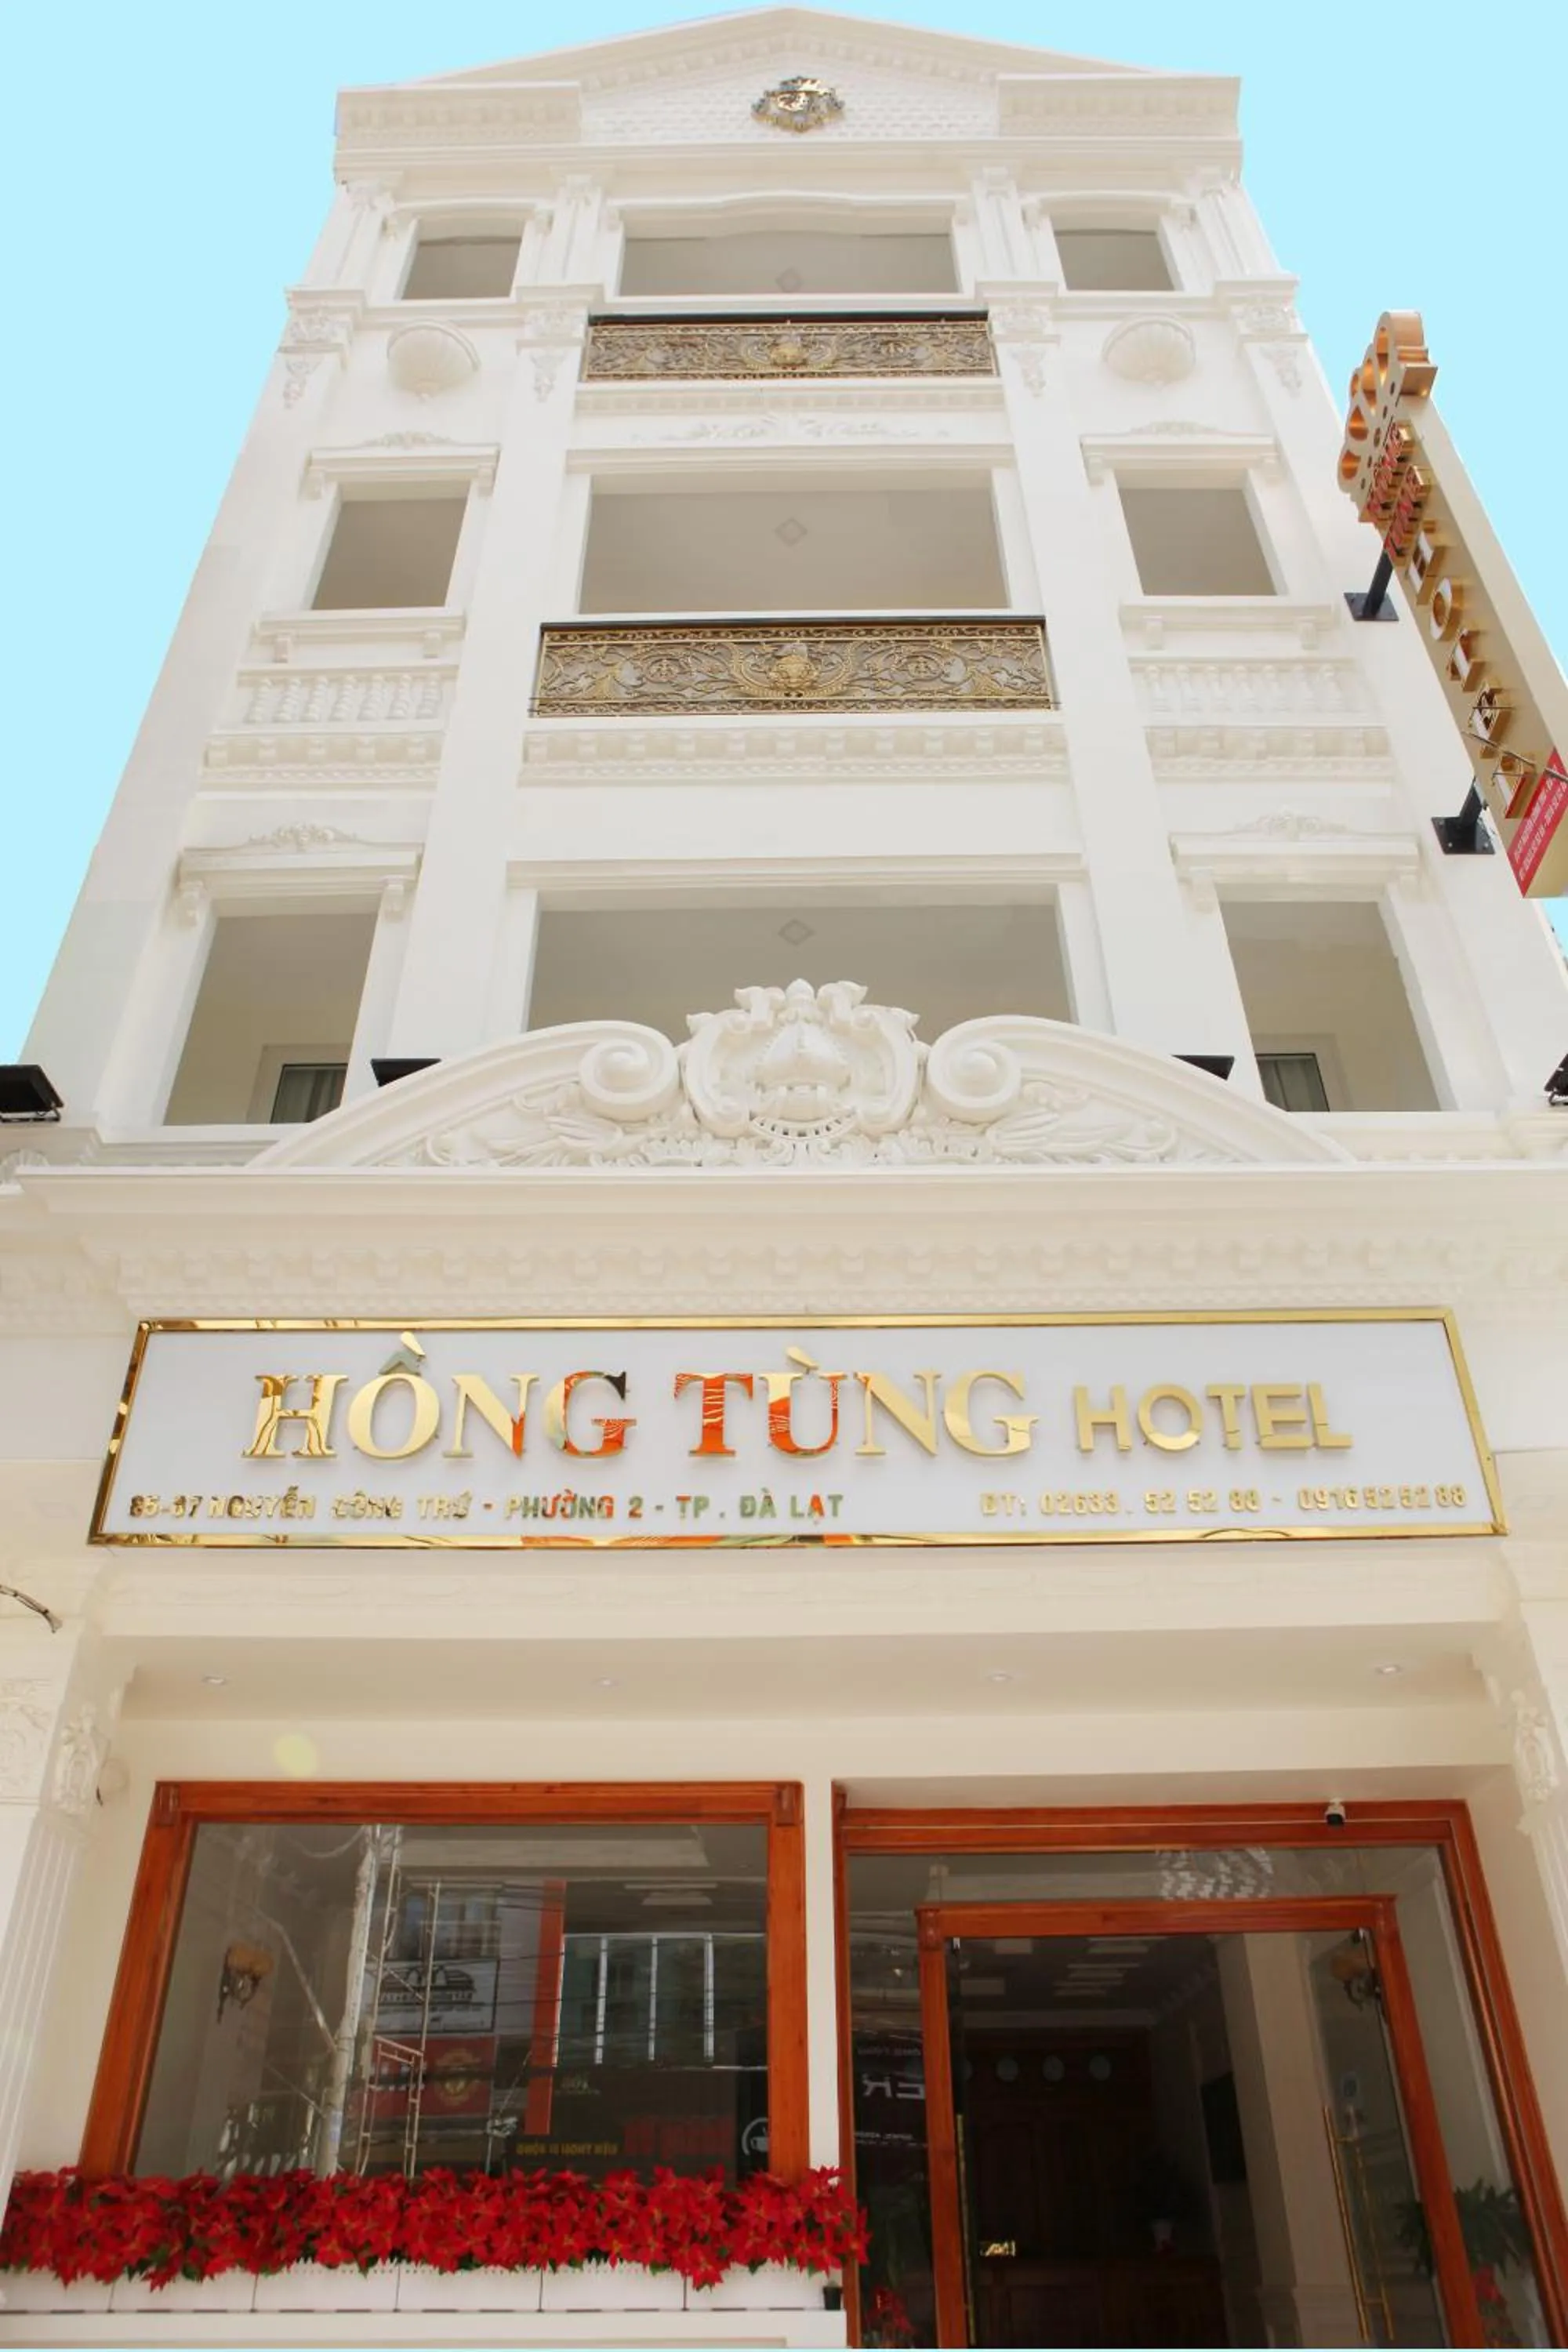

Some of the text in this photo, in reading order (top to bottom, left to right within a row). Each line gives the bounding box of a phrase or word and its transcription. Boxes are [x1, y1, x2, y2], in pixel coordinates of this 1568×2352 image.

[241, 1331, 1354, 1461] HỒNG TÙNG HOTEL
[505, 1488, 615, 1519] PHƯỜNG
[628, 1495, 644, 1519] 2
[739, 1487, 778, 1519] ĐÀ
[790, 1494, 844, 1526] LẠT
[1145, 1490, 1177, 1515] 52
[1187, 1490, 1219, 1514] 52
[1229, 1487, 1261, 1512] 88
